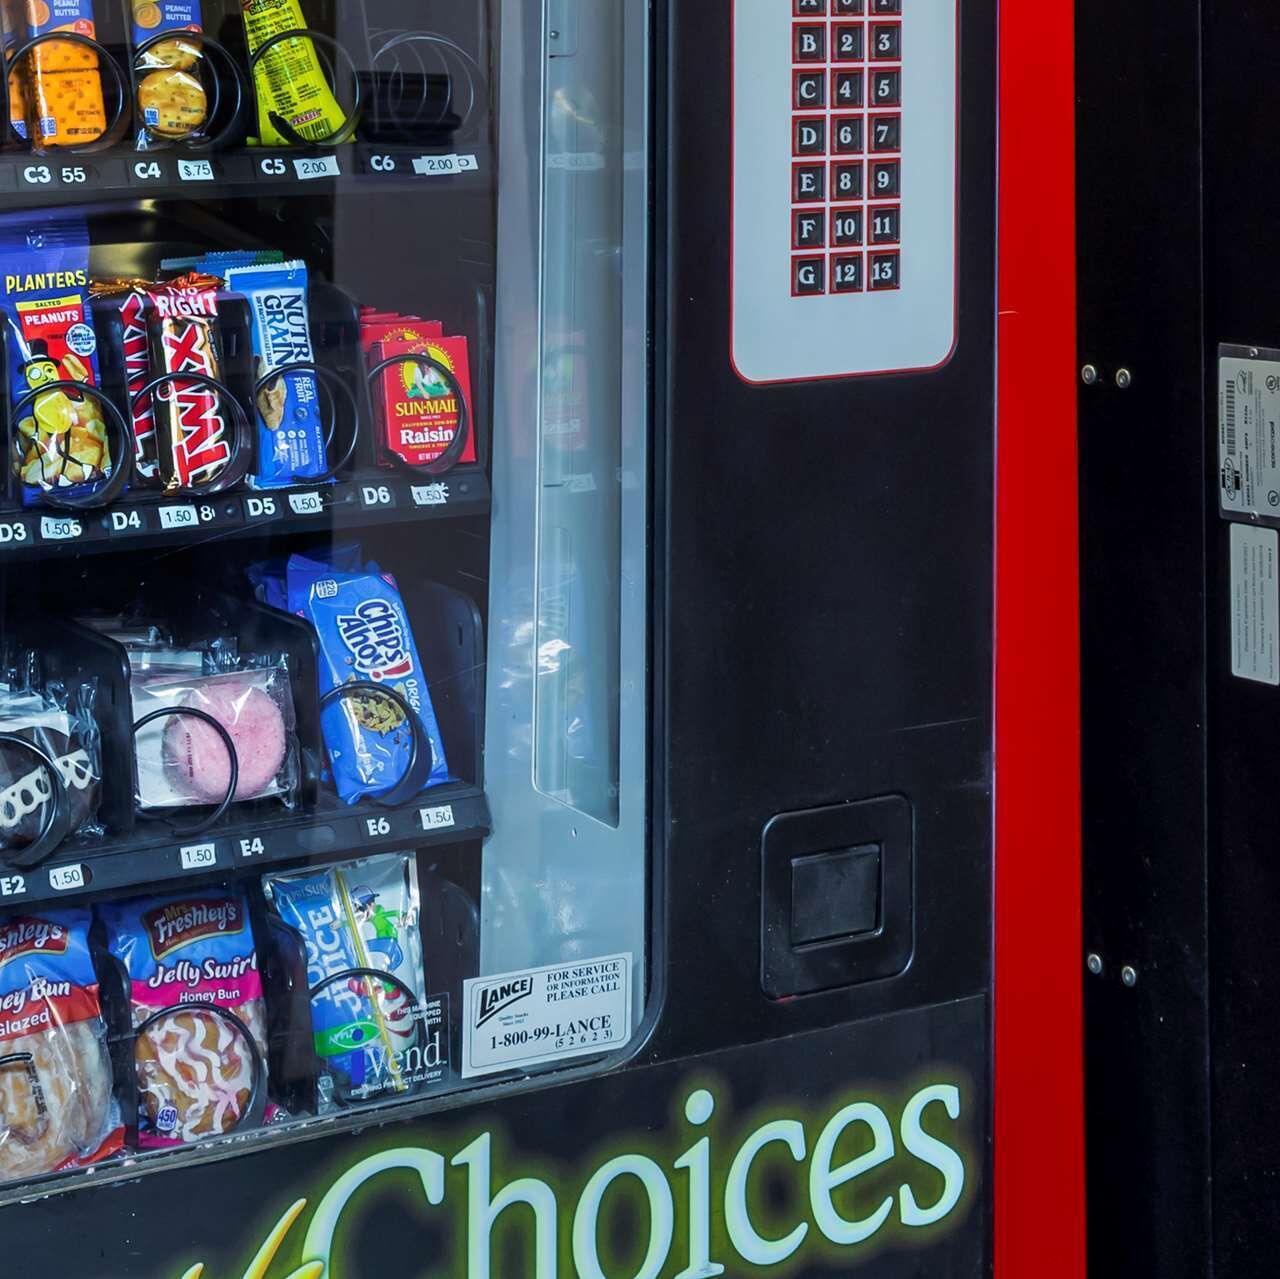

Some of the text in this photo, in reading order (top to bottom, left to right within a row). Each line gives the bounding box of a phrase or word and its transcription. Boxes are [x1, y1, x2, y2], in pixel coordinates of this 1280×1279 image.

[53, 0, 80, 8] PEANUT
[54, 8, 80, 16] BUTTER
[134, 162, 161, 178] C4
[184, 163, 211, 177] $.75
[261, 159, 286, 175] C5
[302, 161, 327, 175] 2.00
[370, 155, 395, 171] C6
[24, 166, 51, 183] C3
[878, 171, 889, 188] 9
[802, 220, 815, 238] F
[836, 219, 855, 236] 10
[874, 217, 890, 234] 11
[835, 265, 855, 282] 12
[872, 263, 892, 280] 13
[6, 270, 86, 294] PLANTERS
[35, 300, 61, 308] SALTED
[157, 292, 218, 317] RIGHT
[25, 310, 79, 325] PEANUTS
[264, 295, 294, 366] GRAIN
[162, 323, 230, 488] TWIX
[363, 487, 391, 505] D6
[248, 497, 275, 515] D5
[113, 511, 141, 530] D4
[165, 509, 192, 522] 1.50
[358, 601, 403, 662] Chips
[339, 618, 412, 679] Ahoy!
[367, 818, 390, 835] E6
[186, 849, 212, 862] 1.50
[240, 838, 264, 856] E4
[0, 877, 26, 895] E2
[53, 870, 80, 885] 1.50
[154, 903, 236, 943] Freshley's
[148, 955, 256, 988] Jelly Swirl
[547, 962, 619, 983] FOR SERVICE
[32, 980, 69, 1000] Bun
[547, 973, 620, 991] OR INFORMATION
[179, 988, 240, 1003] Honey Bun
[480, 979, 527, 1019] LANCE
[547, 982, 620, 1002] PLEASE CALL
[491, 1014, 611, 1049] 1-800-99-LANCE
[365, 1031, 442, 1078] Vend
[301, 1084, 966, 1279] Choices
